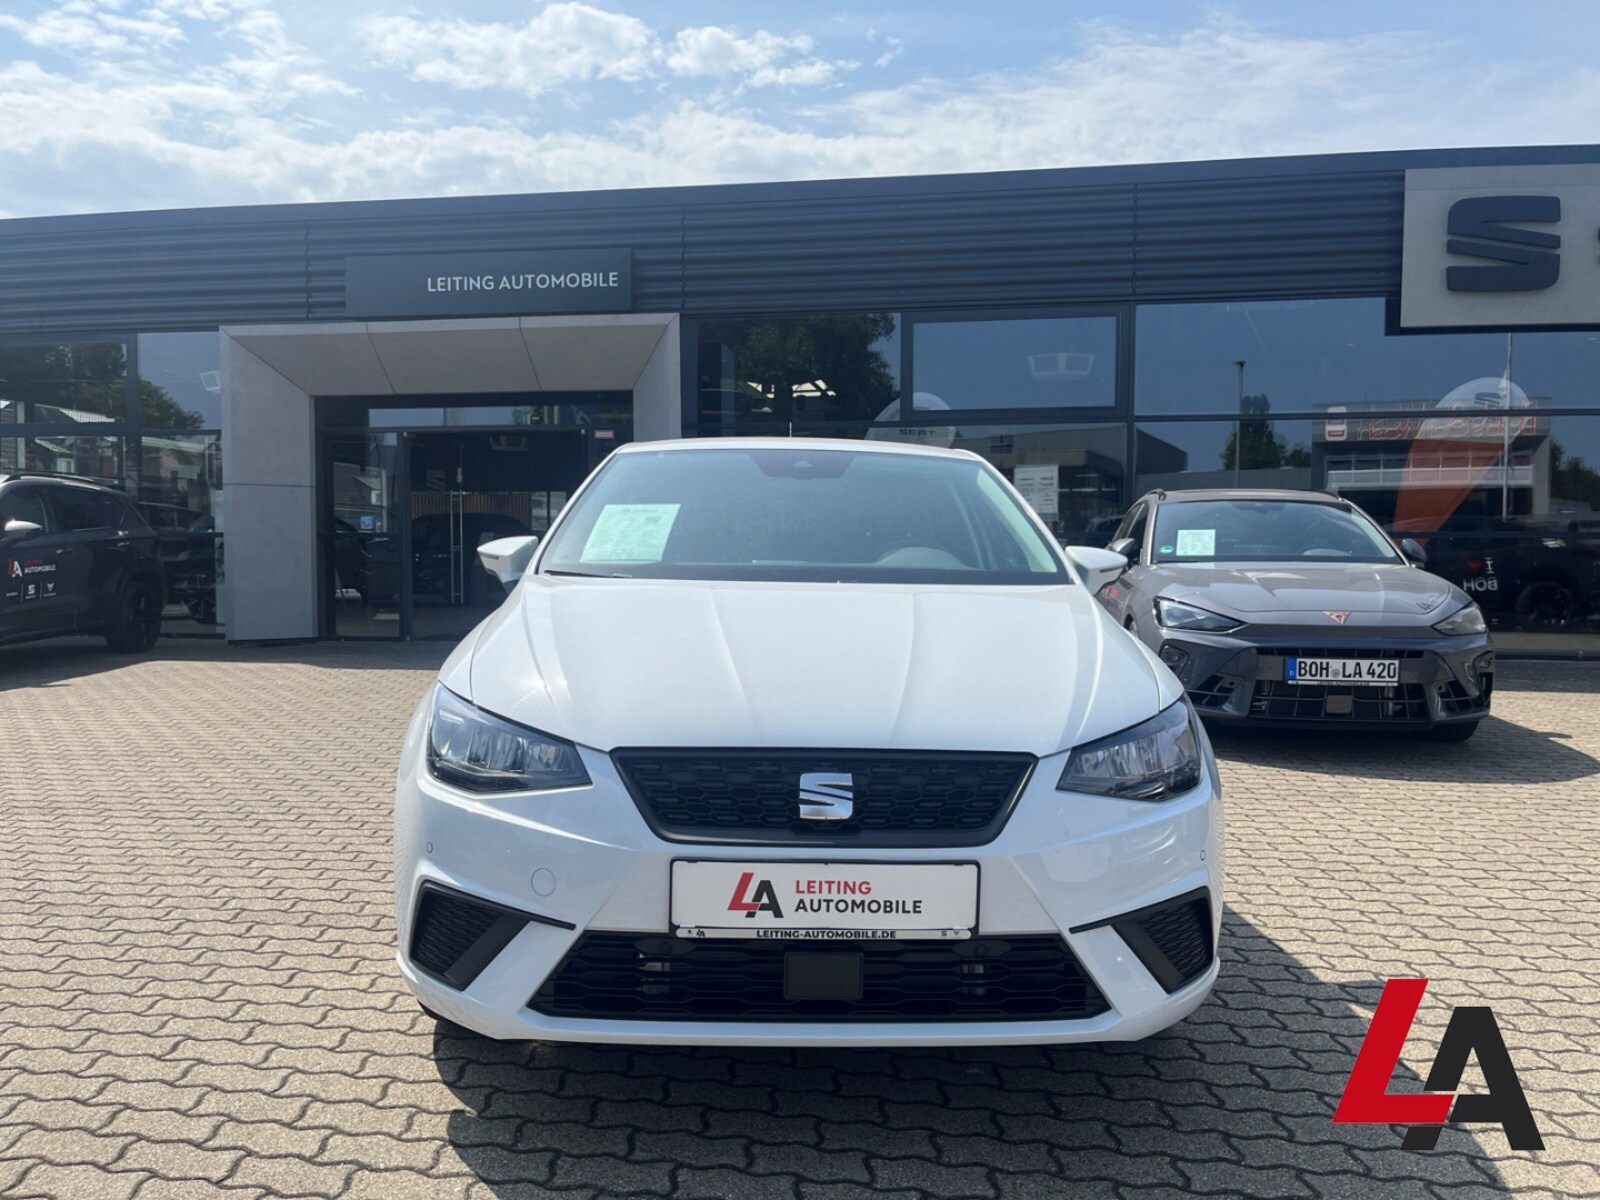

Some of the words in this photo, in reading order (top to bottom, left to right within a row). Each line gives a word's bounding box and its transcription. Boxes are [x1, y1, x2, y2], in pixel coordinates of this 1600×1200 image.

[427, 275, 495, 292] LEITING
[499, 271, 619, 290] AUTOMOBILE
[899, 428, 936, 437] SEAT
[1298, 661, 1329, 678] BOH
[1342, 662, 1362, 679] LA
[1366, 662, 1397, 679] 420
[727, 872, 784, 918] LA
[795, 880, 872, 895] LEITING
[794, 899, 923, 914] AUTOMOBILE
[756, 930, 897, 939] LEITING-AUTOMOBILE.DE
